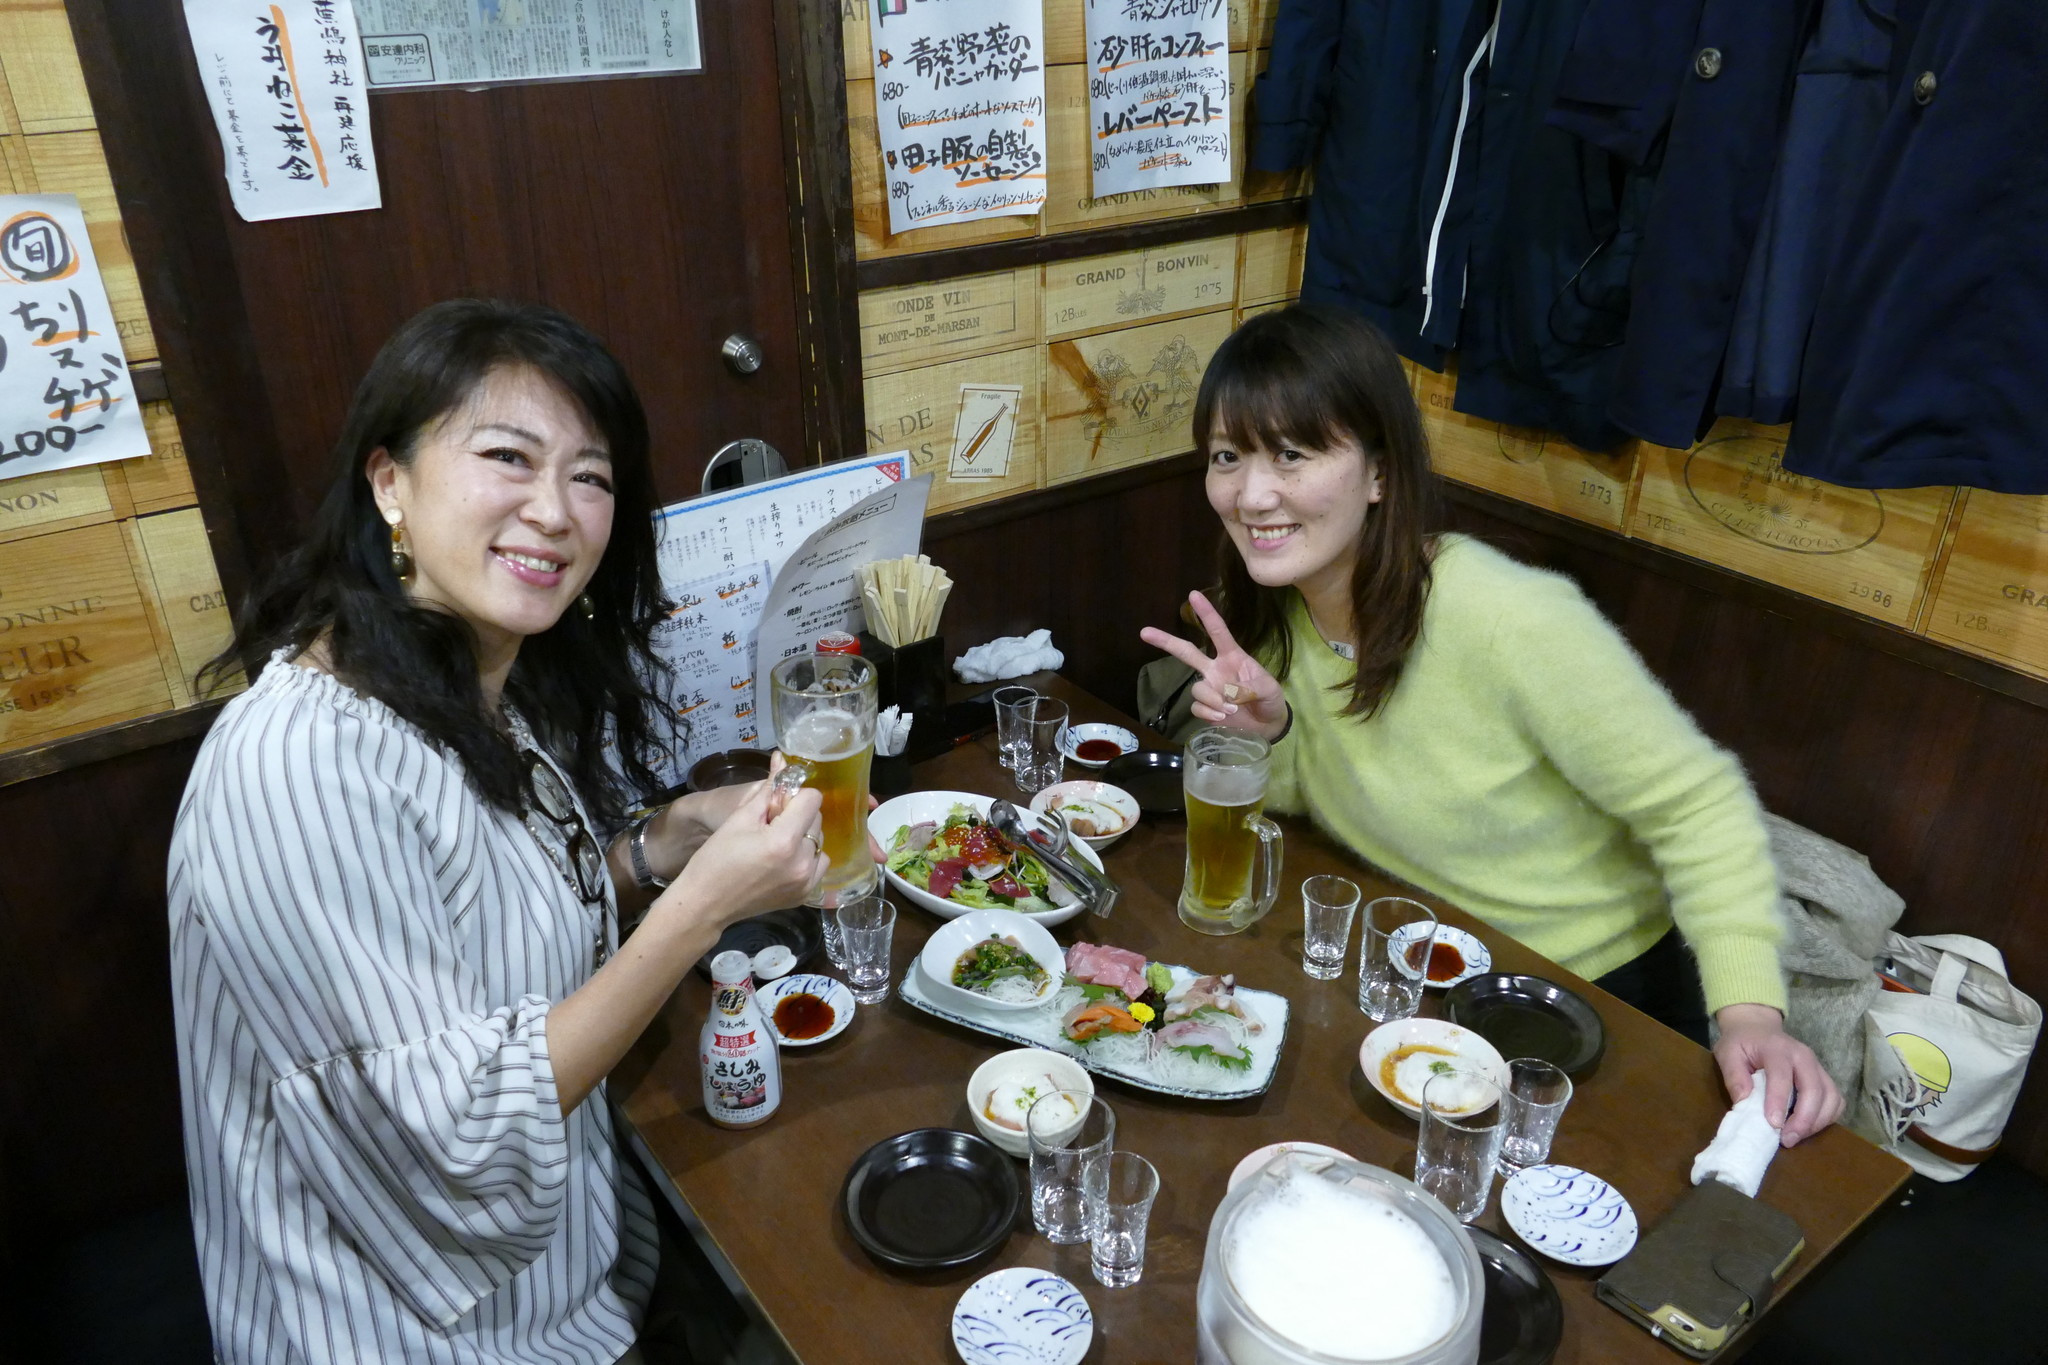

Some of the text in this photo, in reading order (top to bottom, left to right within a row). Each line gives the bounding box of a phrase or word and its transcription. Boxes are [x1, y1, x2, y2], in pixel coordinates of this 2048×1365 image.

[661, 10, 673, 58] けが人なし
[381, 43, 425, 56] 安達内科
[395, 56, 426, 65] クリニック
[904, 22, 1031, 77] 青森野菜の
[256, 17, 314, 180] うみねこ募金
[1104, 94, 1223, 135] レバーペースト
[954, 152, 1042, 181] ソーセージ
[1078, 192, 1129, 211] GRAND
[1133, 187, 1157, 202] VIN
[1076, 267, 1126, 286] GRAND
[888, 290, 971, 315] ONDE VIN
[924, 313, 935, 323] DE
[878, 317, 981, 345] MONT-DE-MARSAN
[980, 392, 1002, 401] Fragile
[898, 407, 933, 437] DE
[1579, 481, 1612, 505] 1973
[1849, 581, 1893, 609] 1986
[784, 643, 808, 657] 日本酒
[720, 1033, 750, 1048] 超特選
[714, 1058, 761, 1078] さしみ
[709, 1073, 767, 1092] しょうゆ
